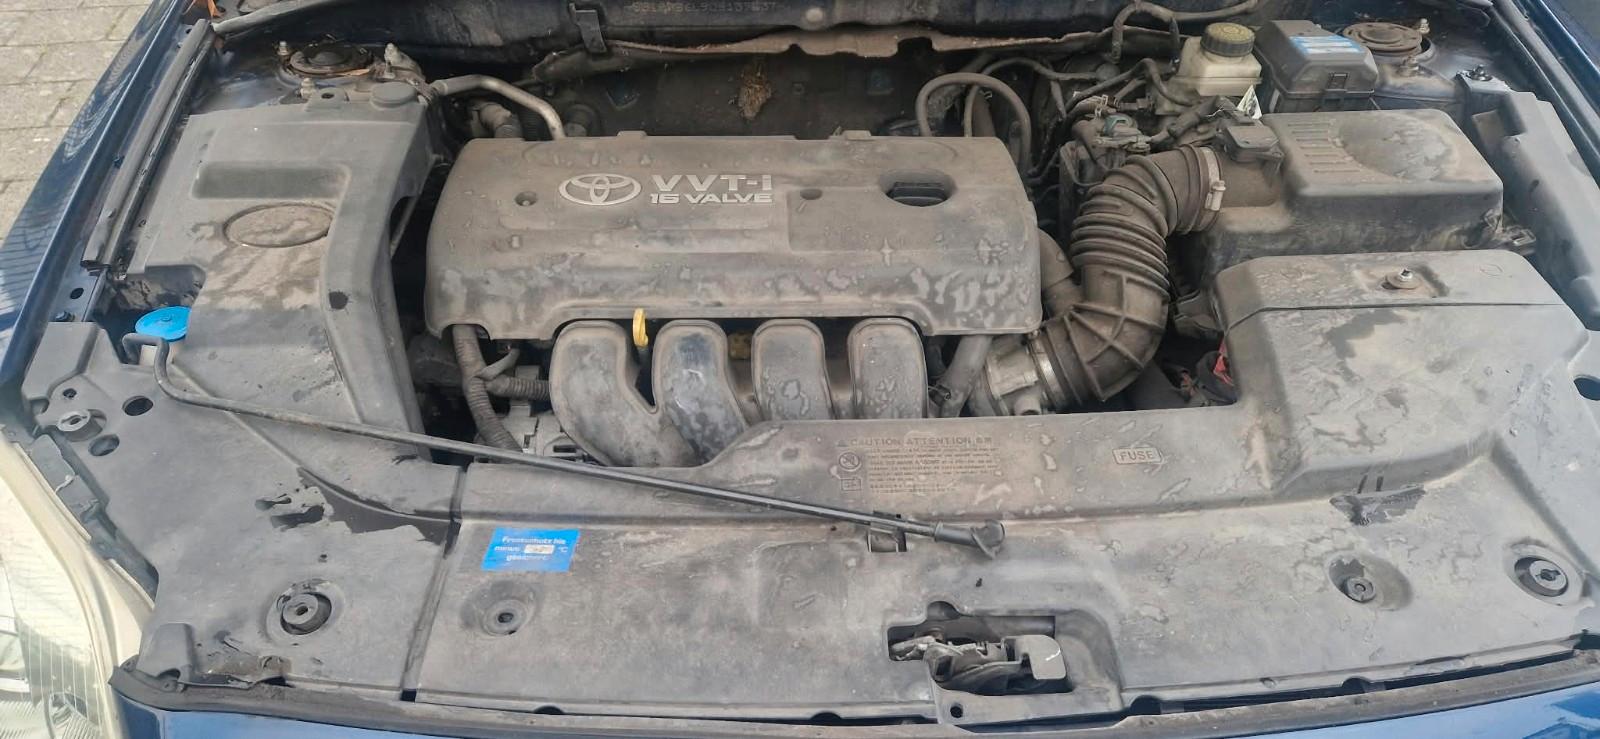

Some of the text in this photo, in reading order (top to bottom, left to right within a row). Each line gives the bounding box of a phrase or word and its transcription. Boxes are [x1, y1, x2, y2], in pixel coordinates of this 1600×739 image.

[650, 193, 773, 204] 16 VALVE
[850, 437, 901, 446] CAUTION
[906, 436, 971, 446] ATTENTION
[1120, 450, 1153, 461] FUSE
